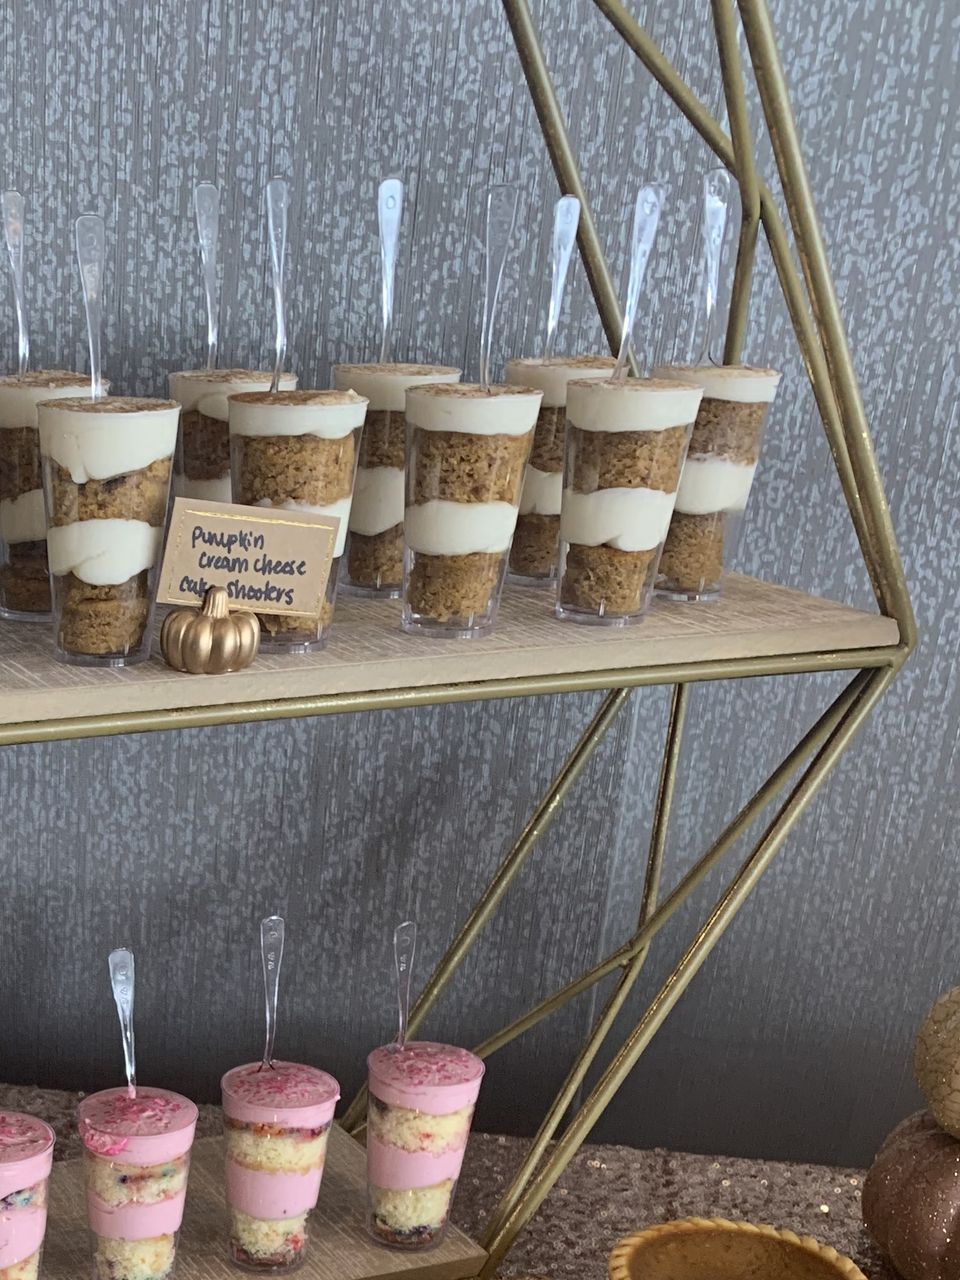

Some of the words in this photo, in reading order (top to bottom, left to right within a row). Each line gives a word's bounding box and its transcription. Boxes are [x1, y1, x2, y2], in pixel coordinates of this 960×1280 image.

[253, 553, 307, 576] cheese
[179, 575, 214, 597] cak
[226, 580, 294, 605] shooters
